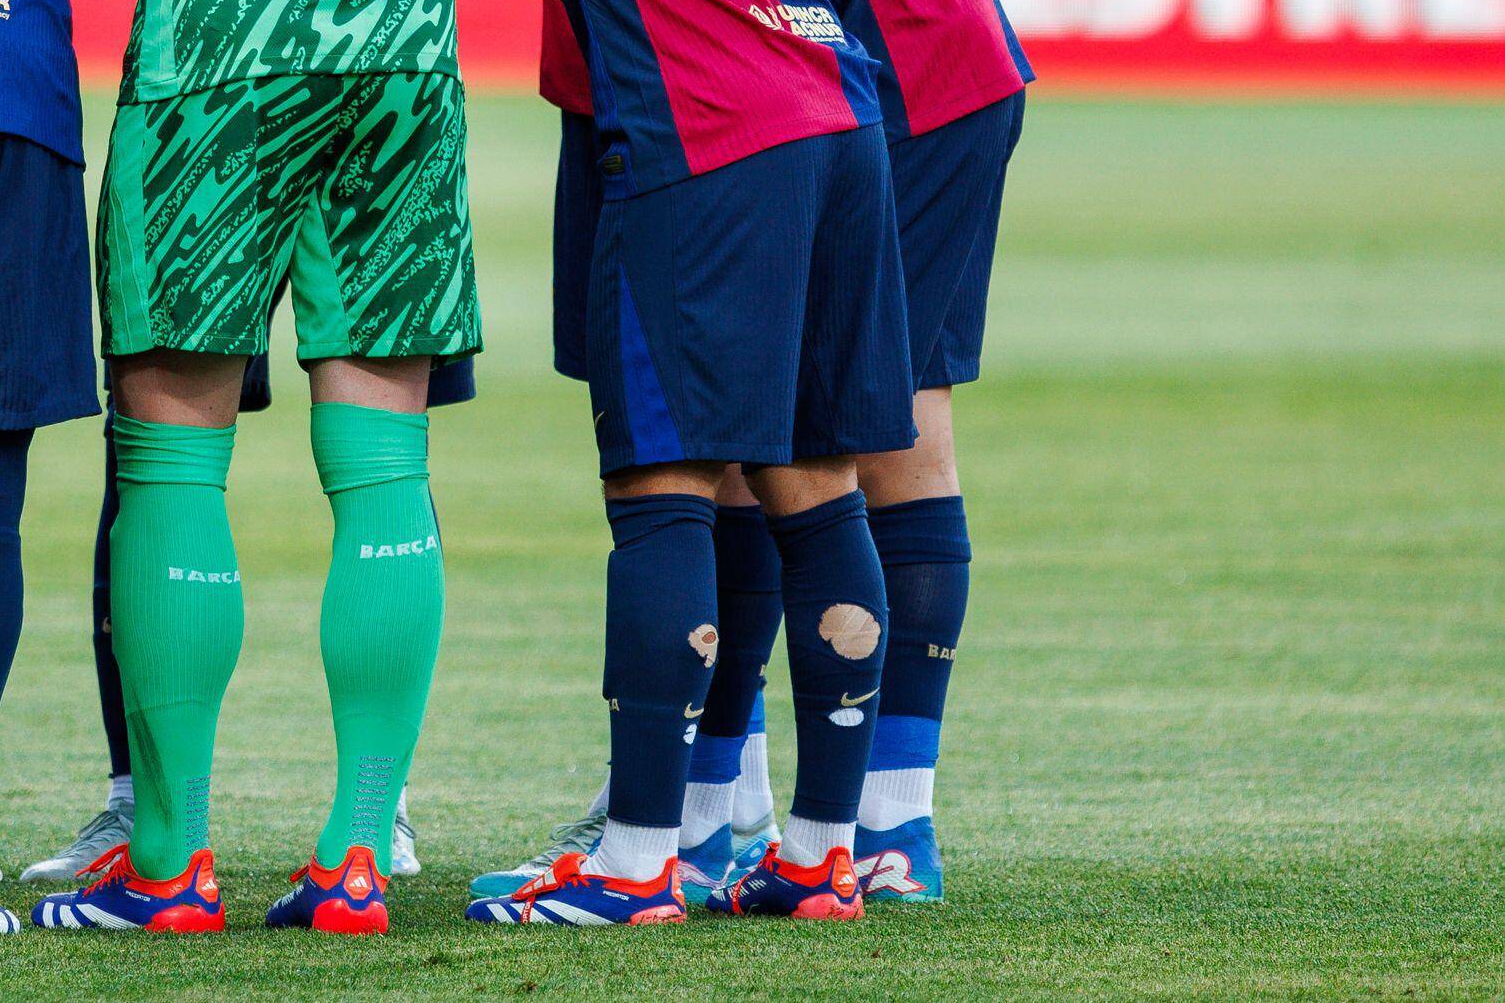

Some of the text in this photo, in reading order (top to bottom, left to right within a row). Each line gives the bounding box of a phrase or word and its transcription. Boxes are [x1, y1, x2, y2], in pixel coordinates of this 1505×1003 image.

[776, 4, 835, 23] UNHCR
[358, 535, 438, 559] BARÇA
[168, 566, 241, 585] BARÇA
[927, 643, 957, 661] BAR
